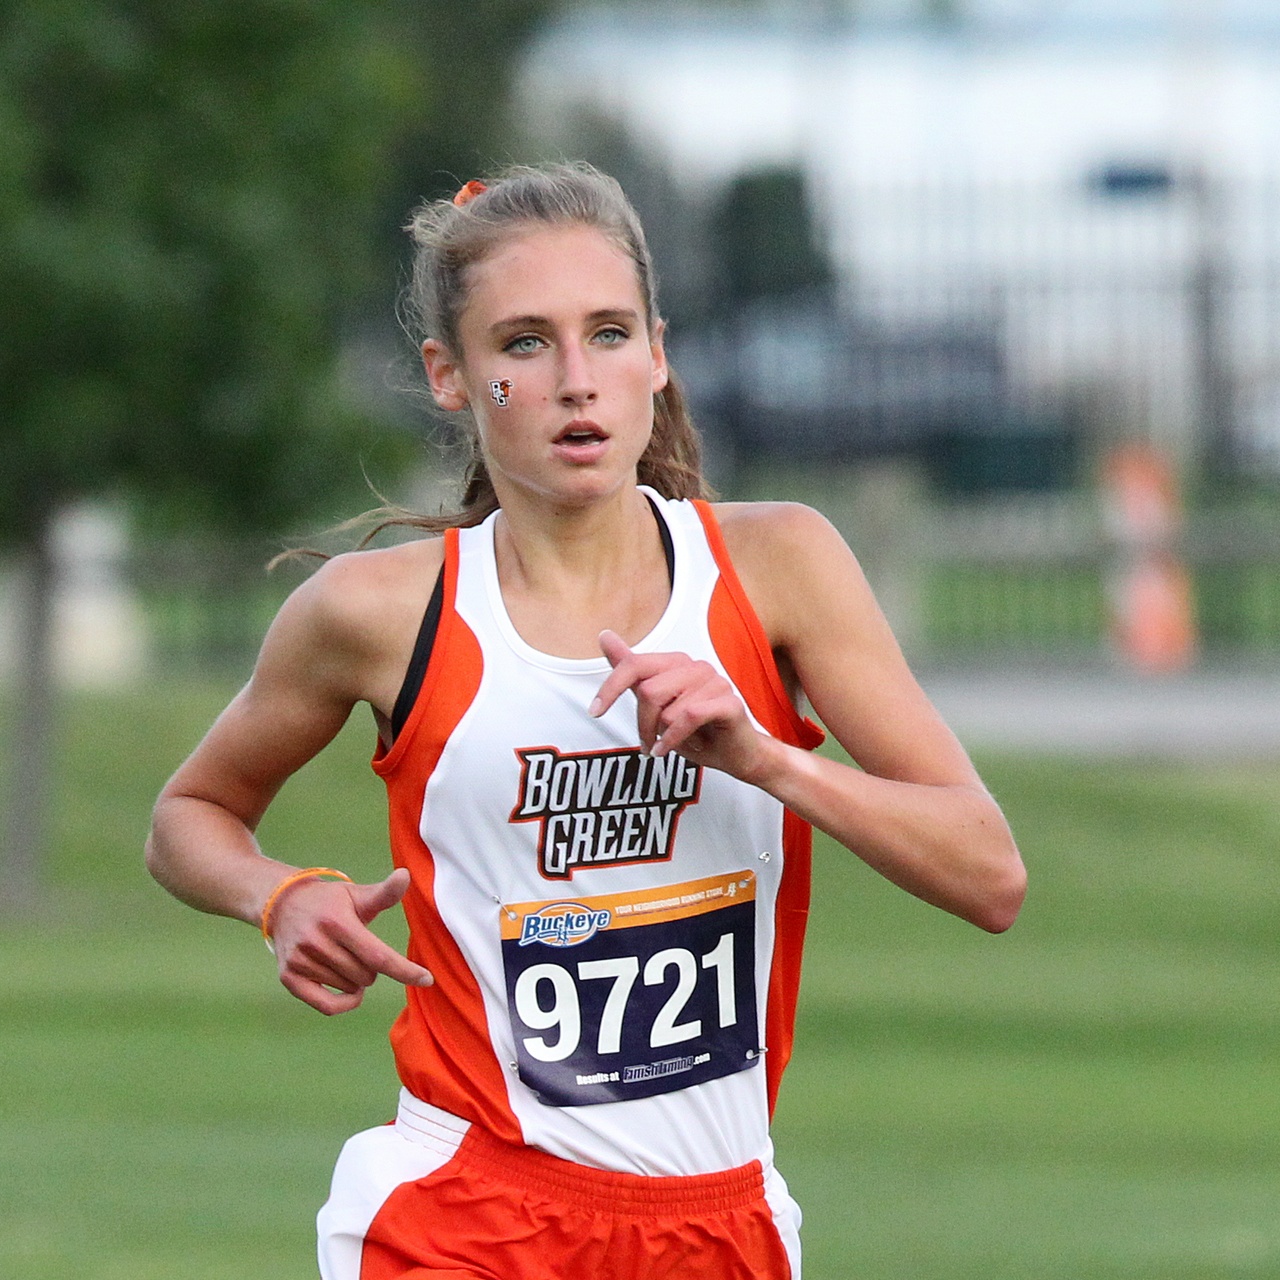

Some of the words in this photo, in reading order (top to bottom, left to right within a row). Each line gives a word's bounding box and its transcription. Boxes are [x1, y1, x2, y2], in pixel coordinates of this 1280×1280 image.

[520, 750, 697, 815] BOWLING
[545, 803, 678, 874] GREEN
[521, 911, 610, 942] Buckeye
[515, 932, 738, 1062] 9721
[576, 1072, 609, 1086] Results
[609, 1072, 620, 1082] at
